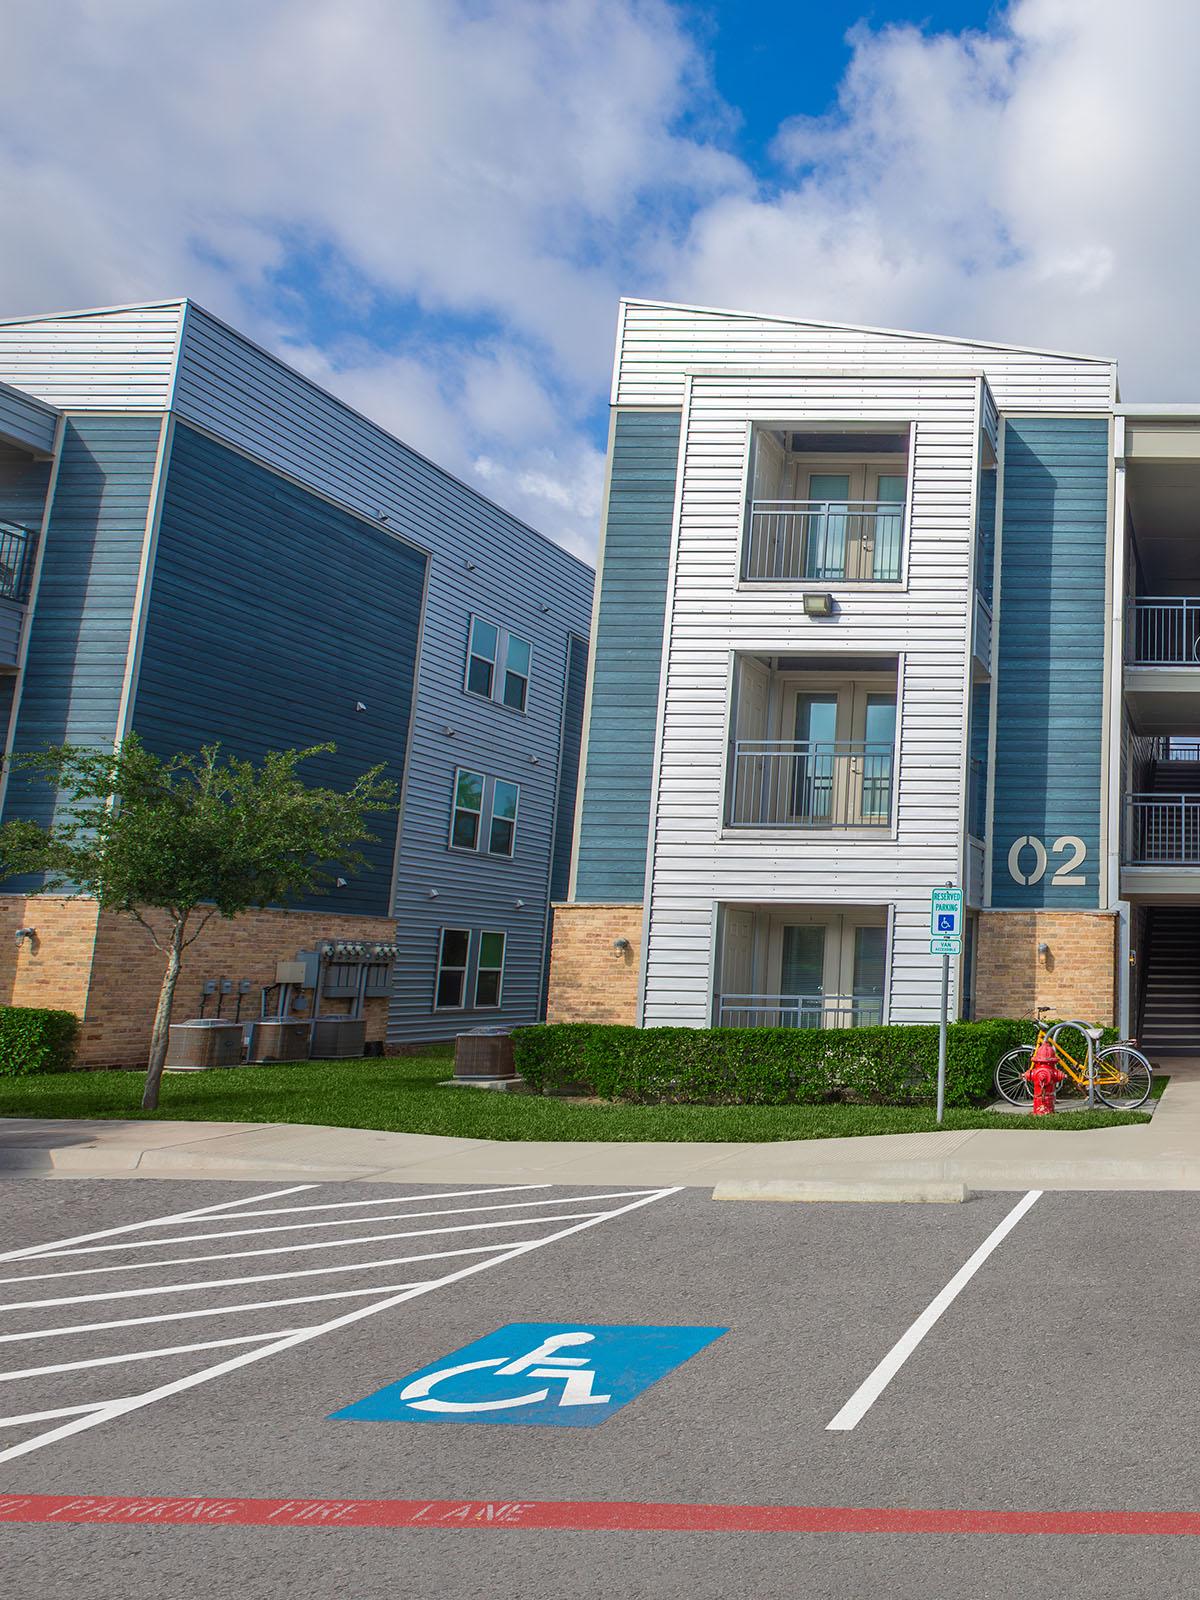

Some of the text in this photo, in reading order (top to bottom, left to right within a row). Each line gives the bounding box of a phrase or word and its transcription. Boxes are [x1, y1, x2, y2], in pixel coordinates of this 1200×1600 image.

[1008, 836, 1087, 886] 02
[933, 892, 961, 901] RESERVED
[935, 903, 958, 912] PARKING
[48, 1500, 245, 1518] PARKING
[267, 1501, 374, 1520] FIRE
[411, 1503, 536, 1522] LANE
